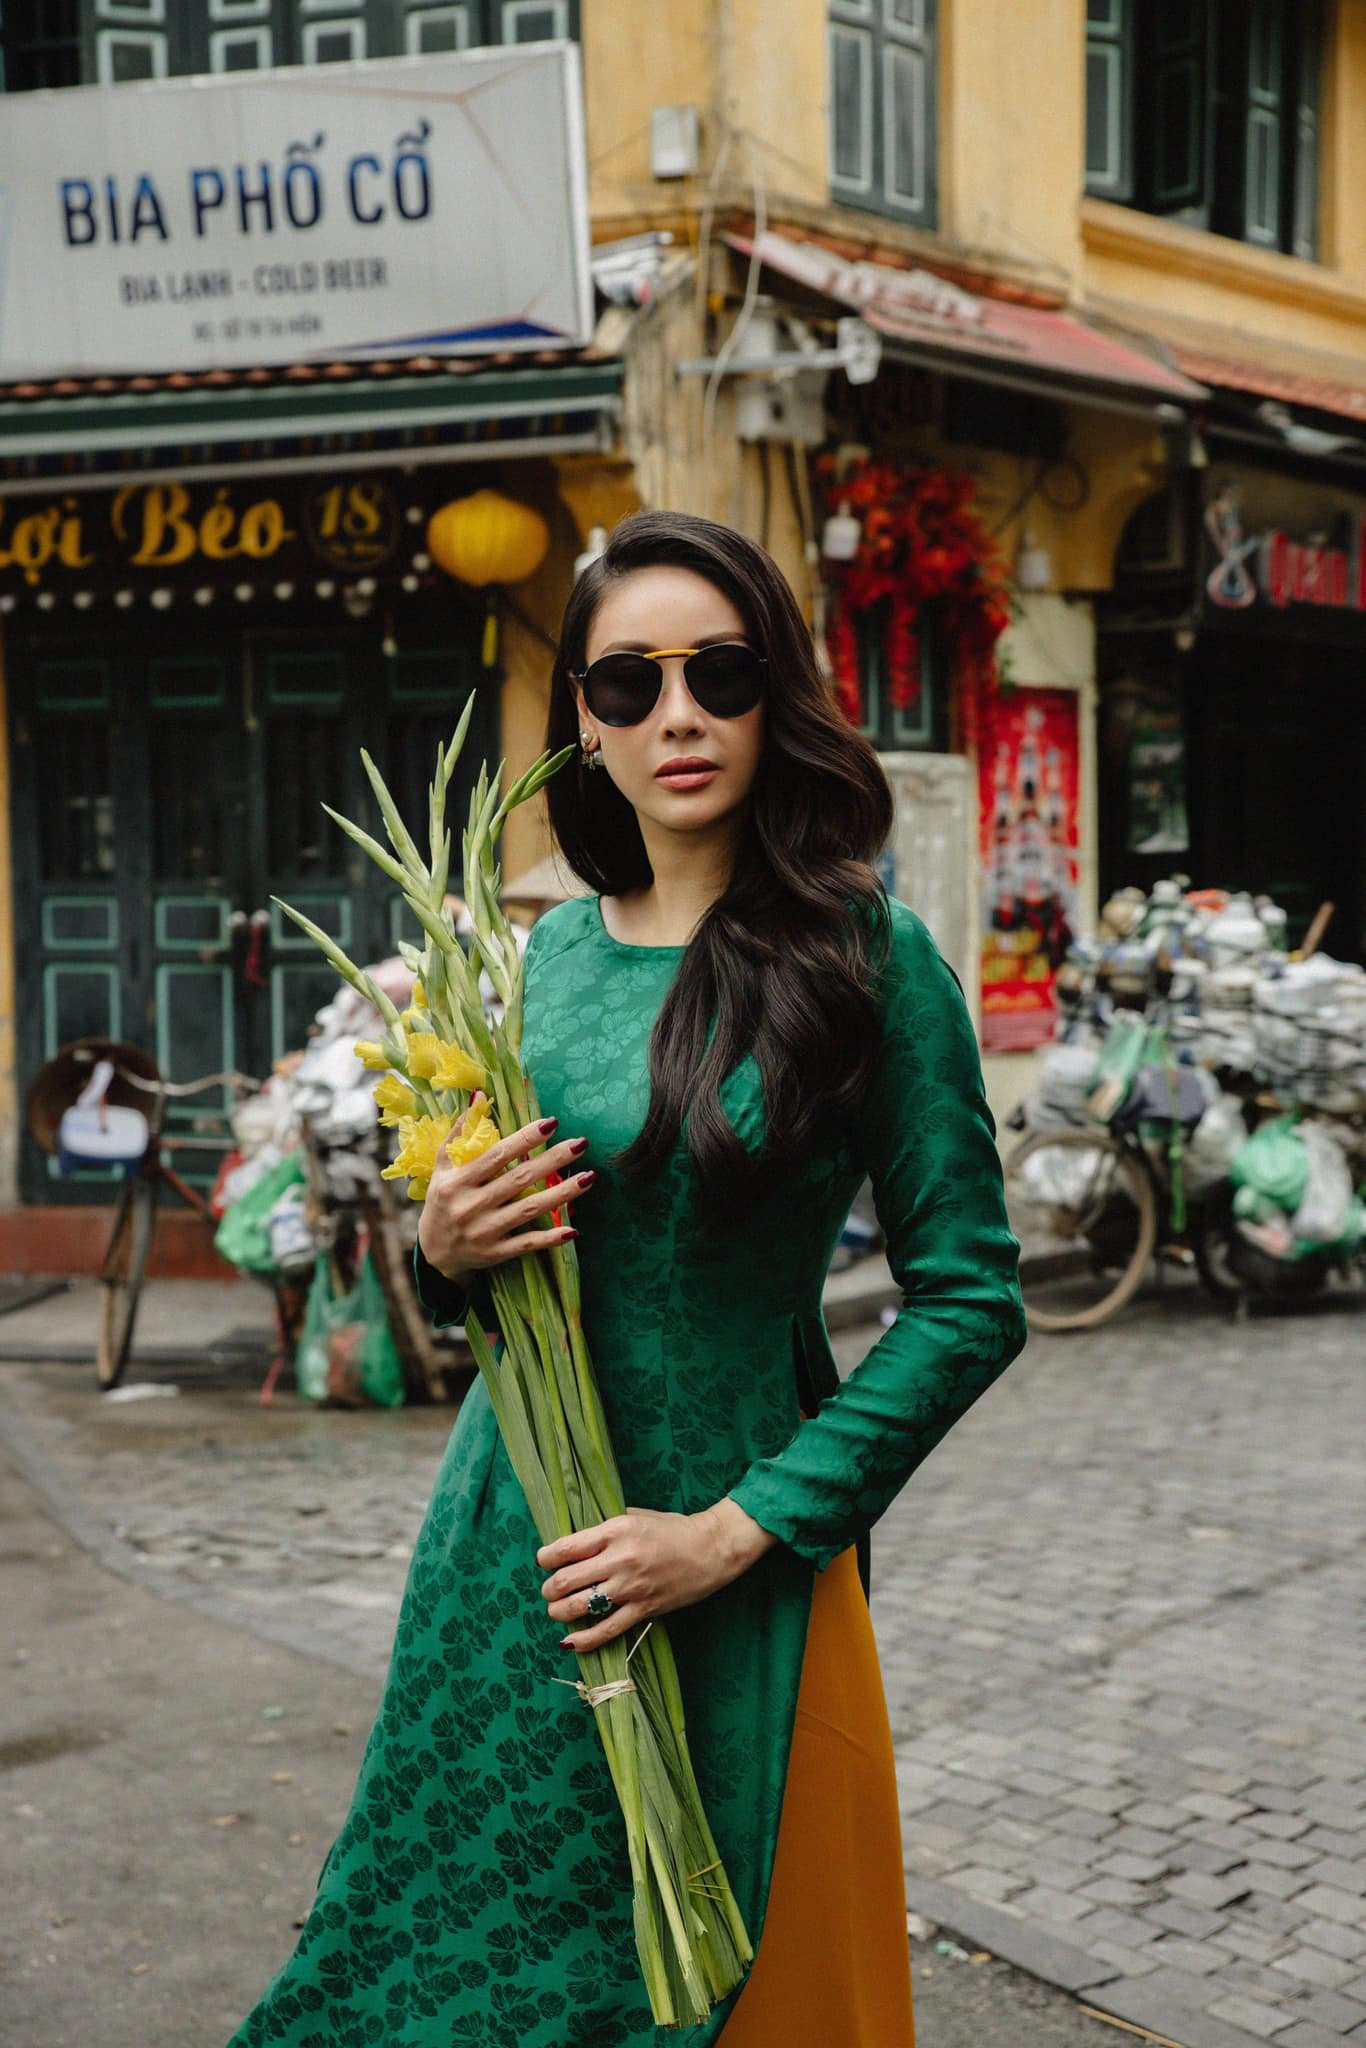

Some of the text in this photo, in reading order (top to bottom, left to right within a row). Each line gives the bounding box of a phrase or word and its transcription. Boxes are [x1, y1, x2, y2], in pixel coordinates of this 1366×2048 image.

[61, 174, 168, 246] BIA
[191, 131, 326, 236] PHỐ
[119, 272, 162, 306] BIA
[253, 260, 319, 295] COLD
[324, 255, 388, 292] BEER
[0, 481, 383, 586] ợi Béo 18
